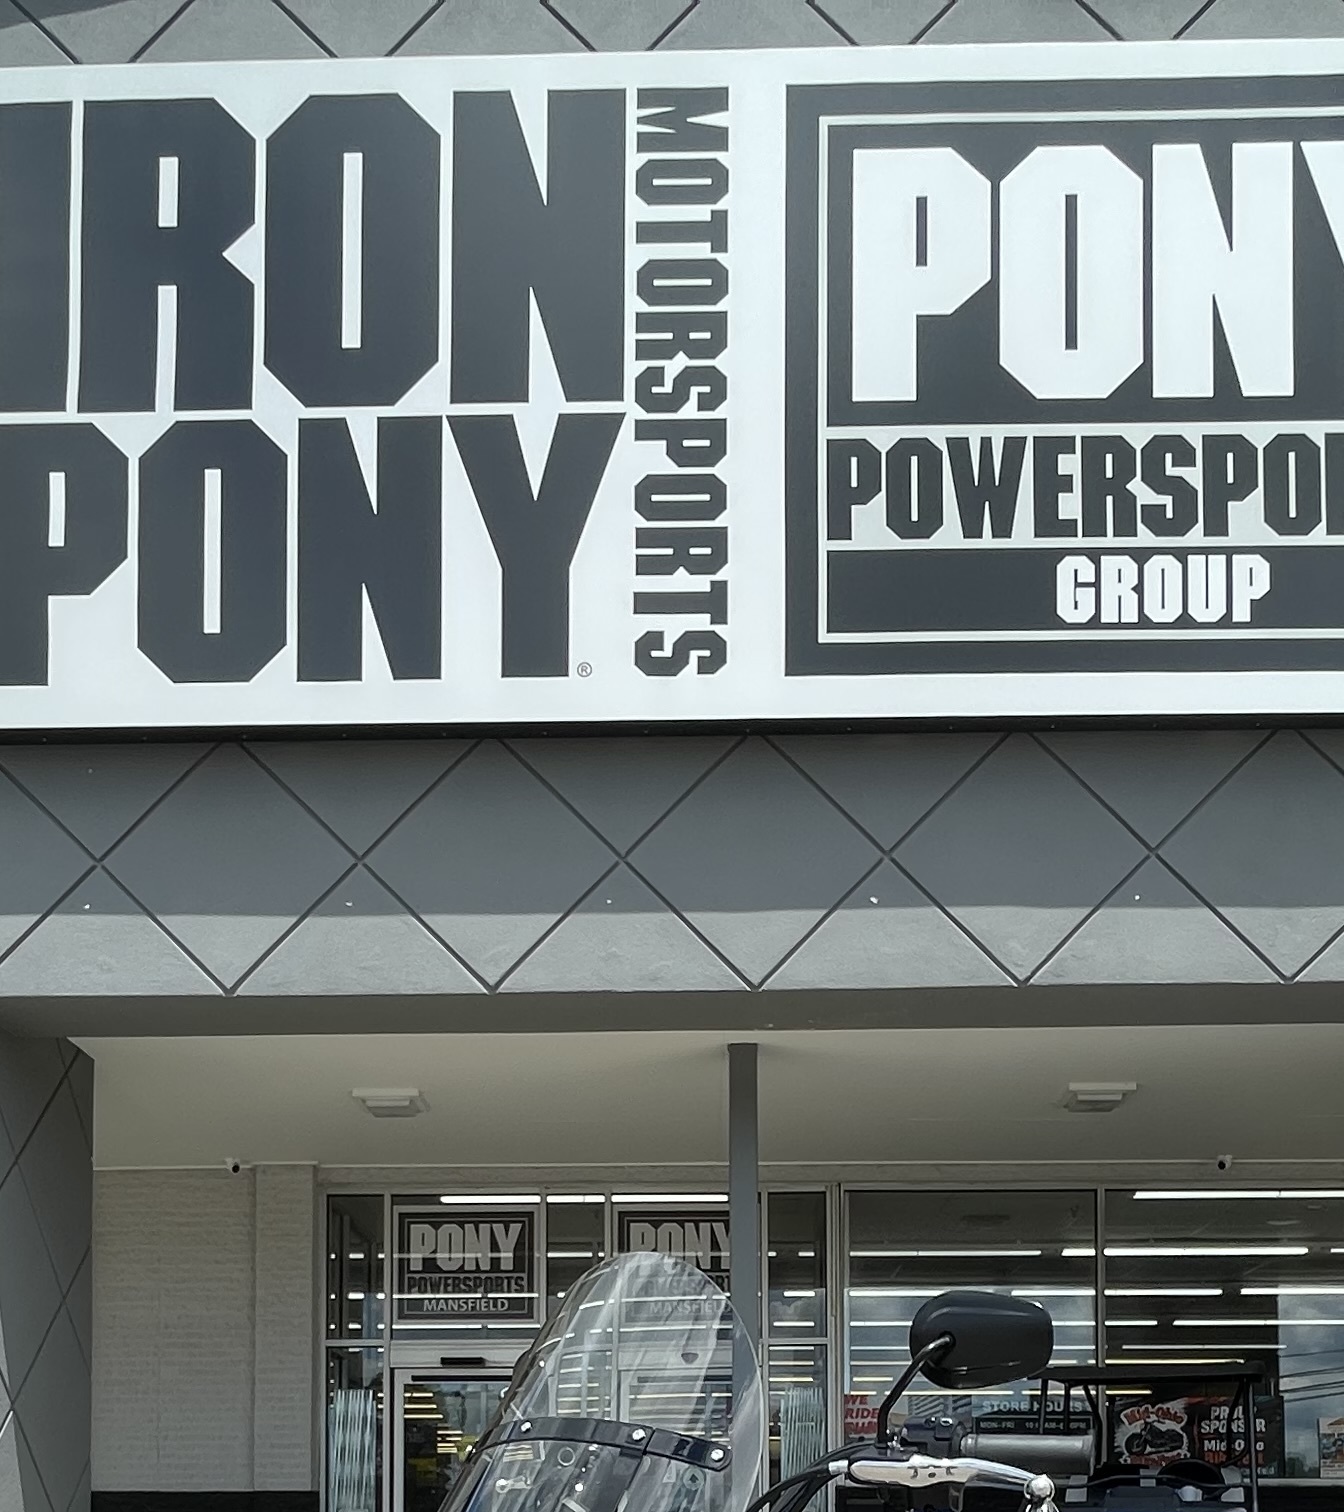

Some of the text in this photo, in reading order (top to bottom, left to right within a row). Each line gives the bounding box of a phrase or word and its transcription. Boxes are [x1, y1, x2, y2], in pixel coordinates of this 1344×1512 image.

[633, 86, 729, 677] MOTORSPORTS
[1056, 553, 1271, 624] GROUP
[409, 1223, 523, 1272] PONY
[630, 1222, 731, 1271] PONY
[407, 1275, 525, 1296] POWERSPORTS
[423, 1298, 509, 1312] MANSFIELD
[982, 1400, 1084, 1412] STORE HOUS
[1200, 1418, 1267, 1434] SPONSR
